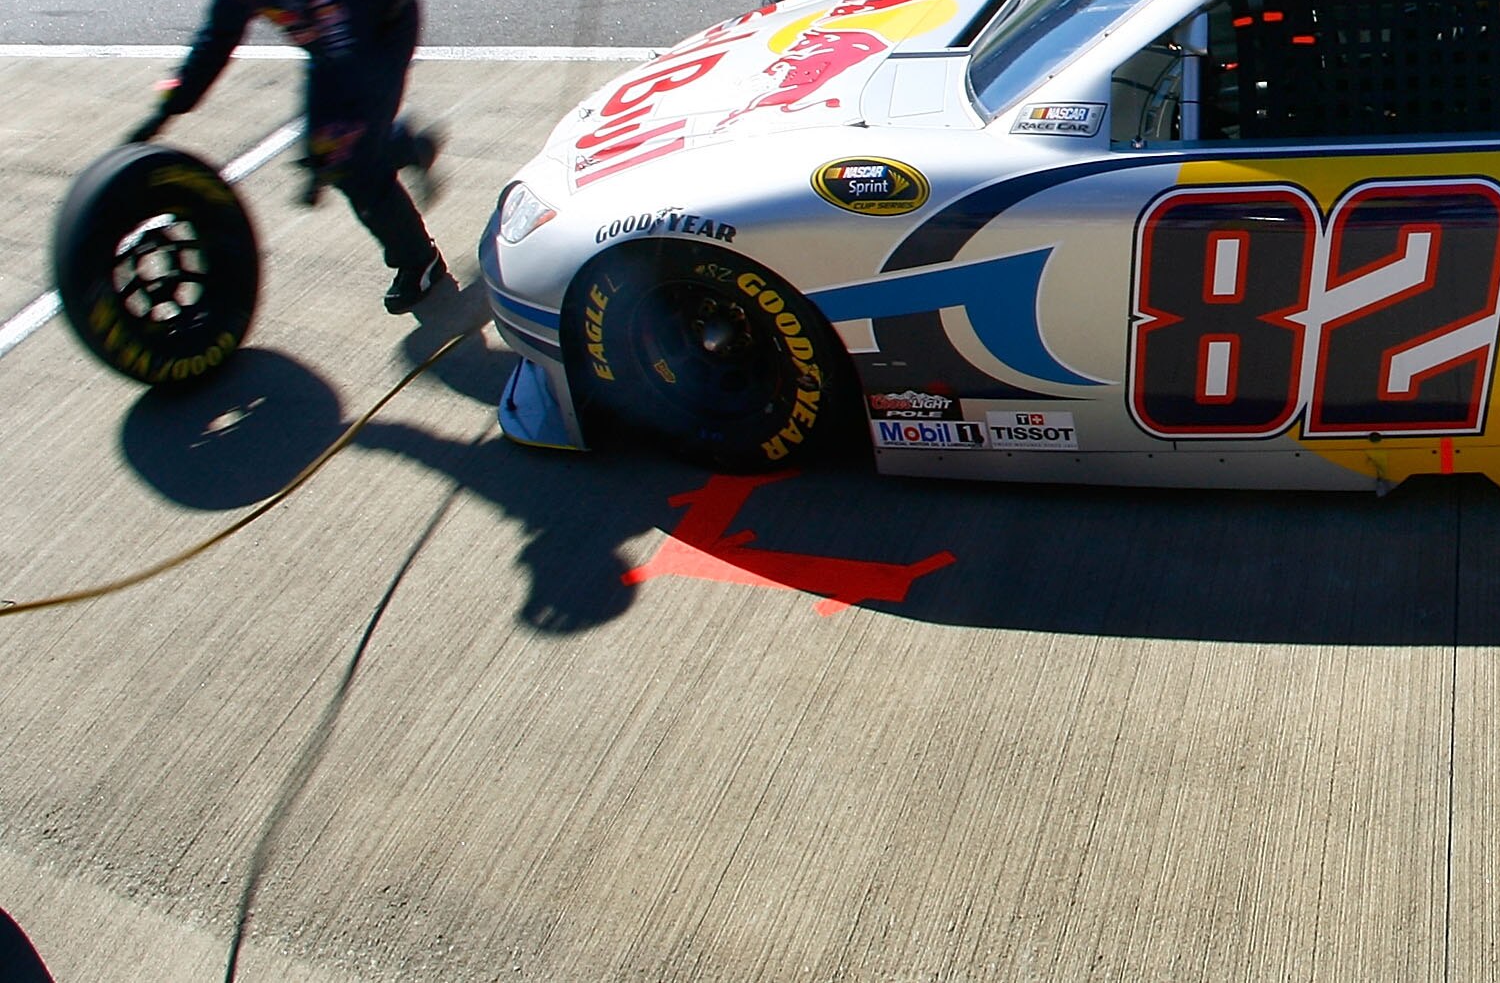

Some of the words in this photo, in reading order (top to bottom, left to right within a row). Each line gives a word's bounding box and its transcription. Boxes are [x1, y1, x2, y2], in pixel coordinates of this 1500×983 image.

[1045, 106, 1086, 120] NASCAR
[1018, 122, 1055, 130] RACE
[1056, 122, 1089, 131] CAR
[843, 166, 884, 178] NASCAR
[849, 179, 888, 196] Sprint
[596, 212, 737, 244] GOODYEAR
[585, 283, 615, 381] EAGLE
[737, 272, 822, 461] GOODYEAR
[911, 397, 952, 409] LIGHT
[880, 422, 950, 442] Mobil
[991, 427, 1074, 440] TISSOT
